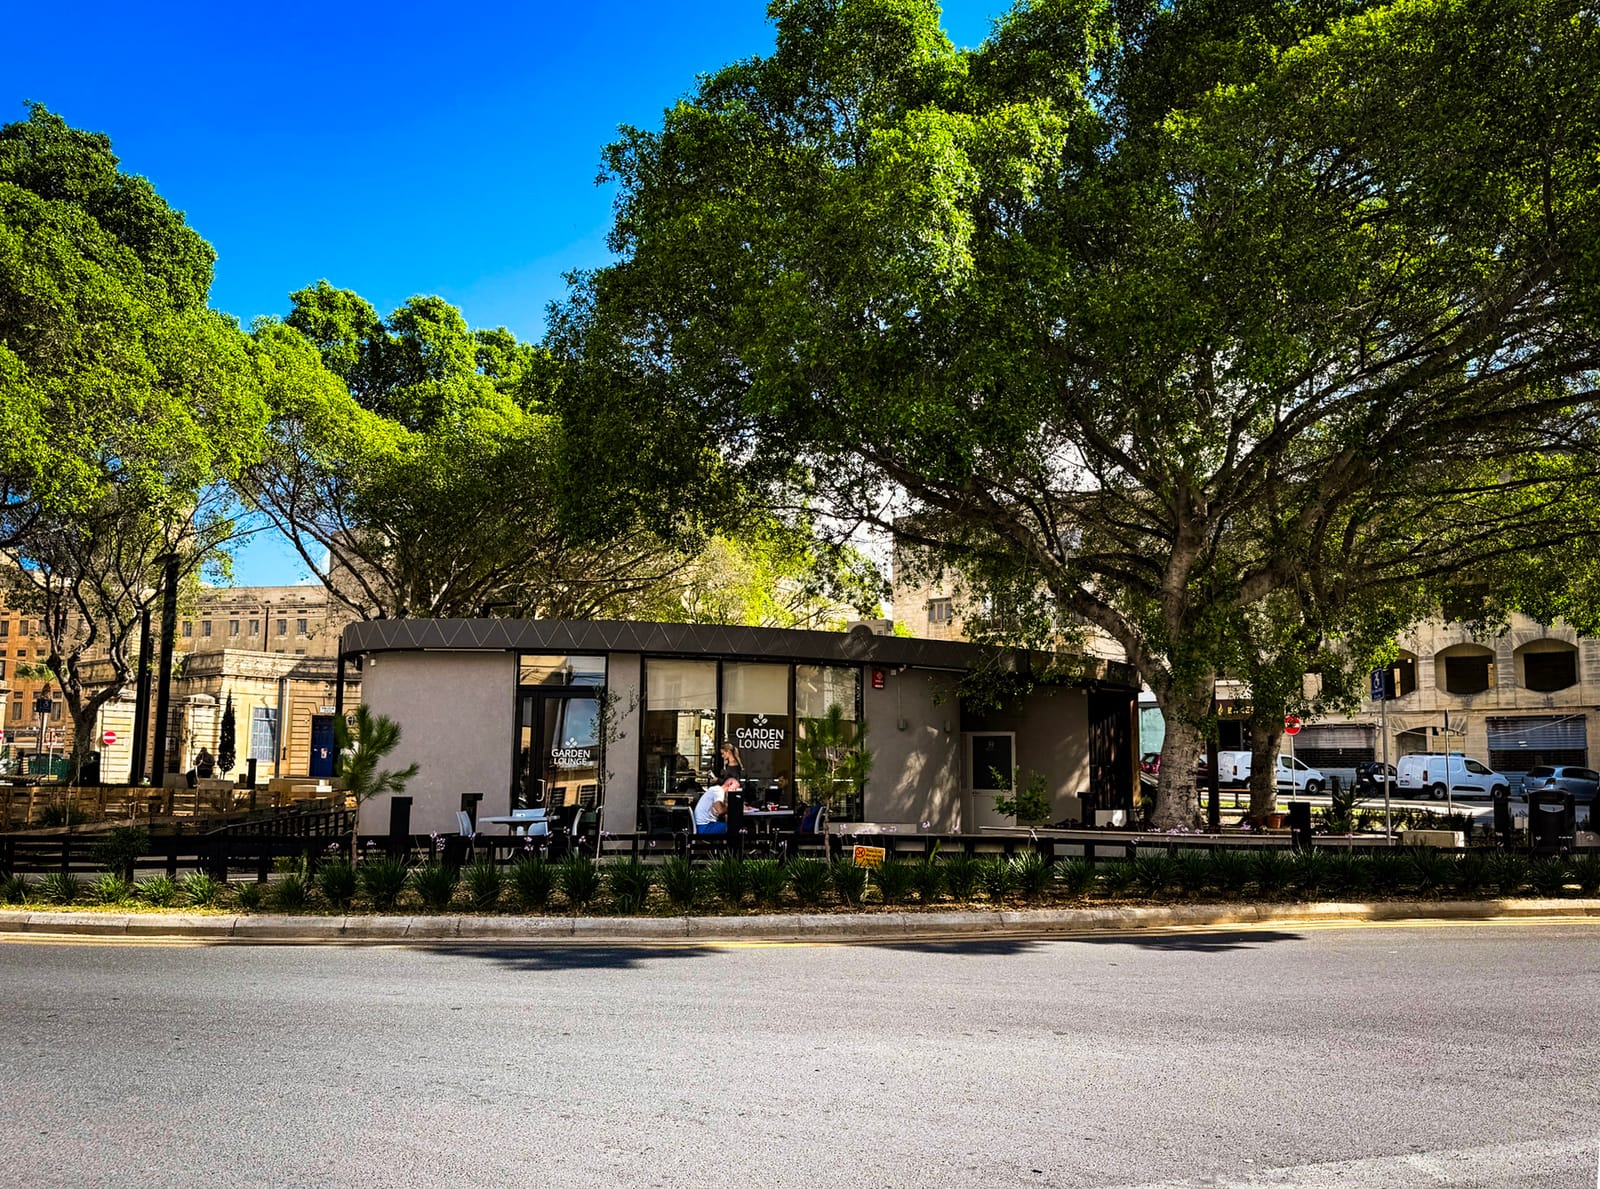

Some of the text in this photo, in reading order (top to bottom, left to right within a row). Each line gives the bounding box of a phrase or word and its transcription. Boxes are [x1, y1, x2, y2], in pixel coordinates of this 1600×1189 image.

[735, 727, 784, 740] GARDEN
[738, 739, 780, 750] LOUNGE
[551, 748, 591, 758] GARDEN
[553, 757, 588, 766] LOUNGE
